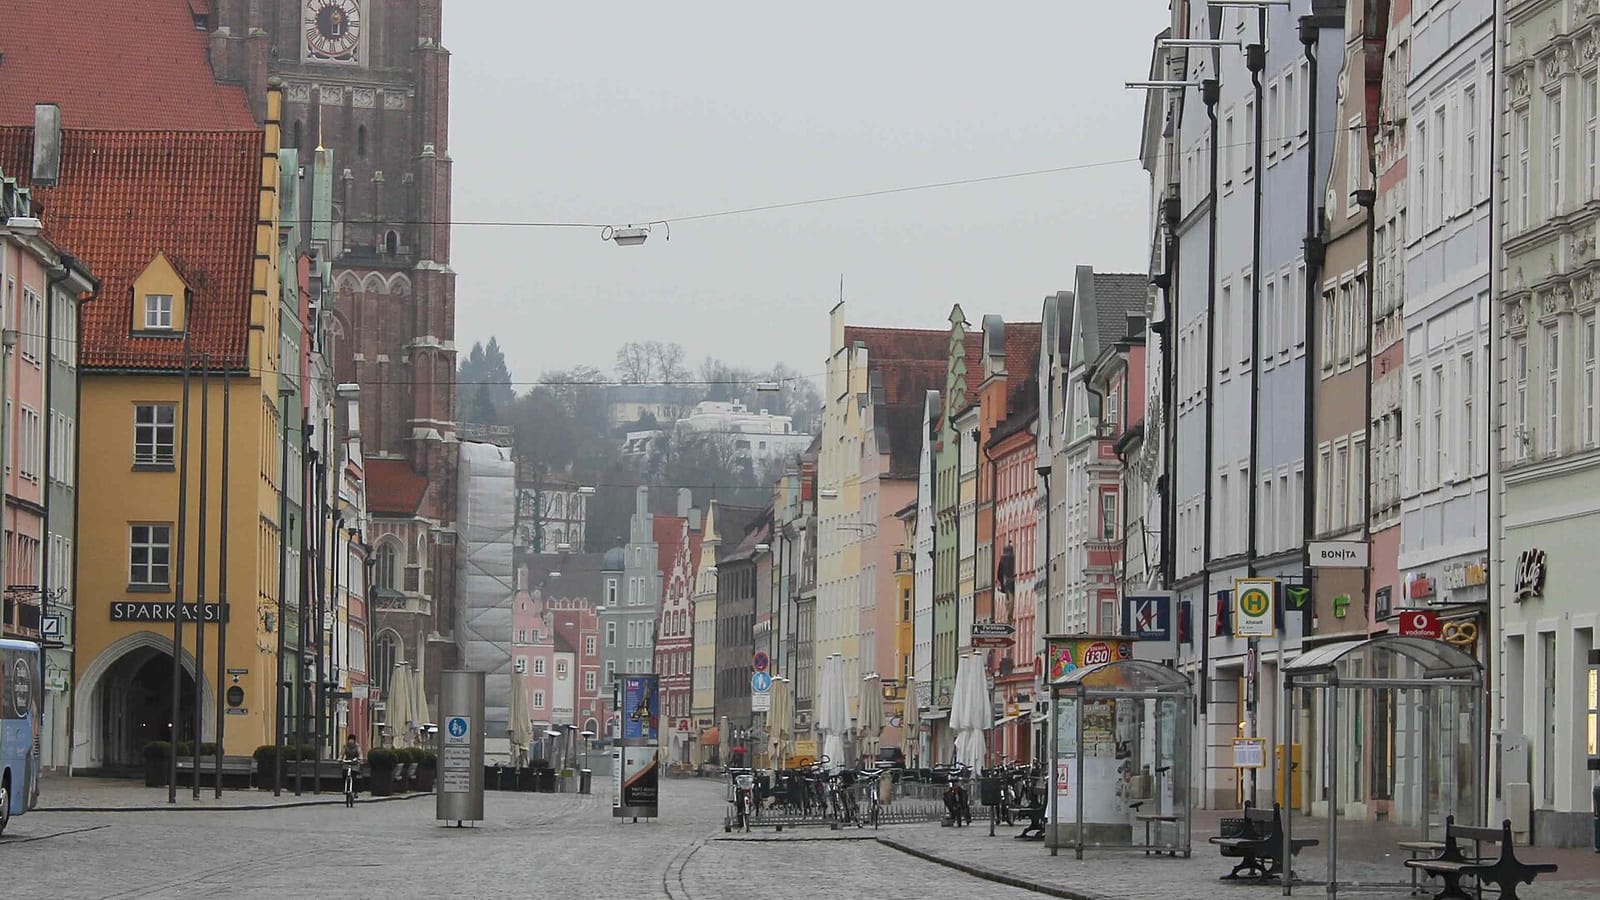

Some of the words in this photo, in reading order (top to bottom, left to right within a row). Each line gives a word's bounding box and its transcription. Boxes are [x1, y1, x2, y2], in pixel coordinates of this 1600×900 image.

[1321, 549, 1356, 560] BONITA
[1247, 594, 1262, 611] H
[114, 603, 221, 620] SPARKASS
[1130, 600, 1165, 632] KL
[1086, 650, 1108, 664] Ü30
